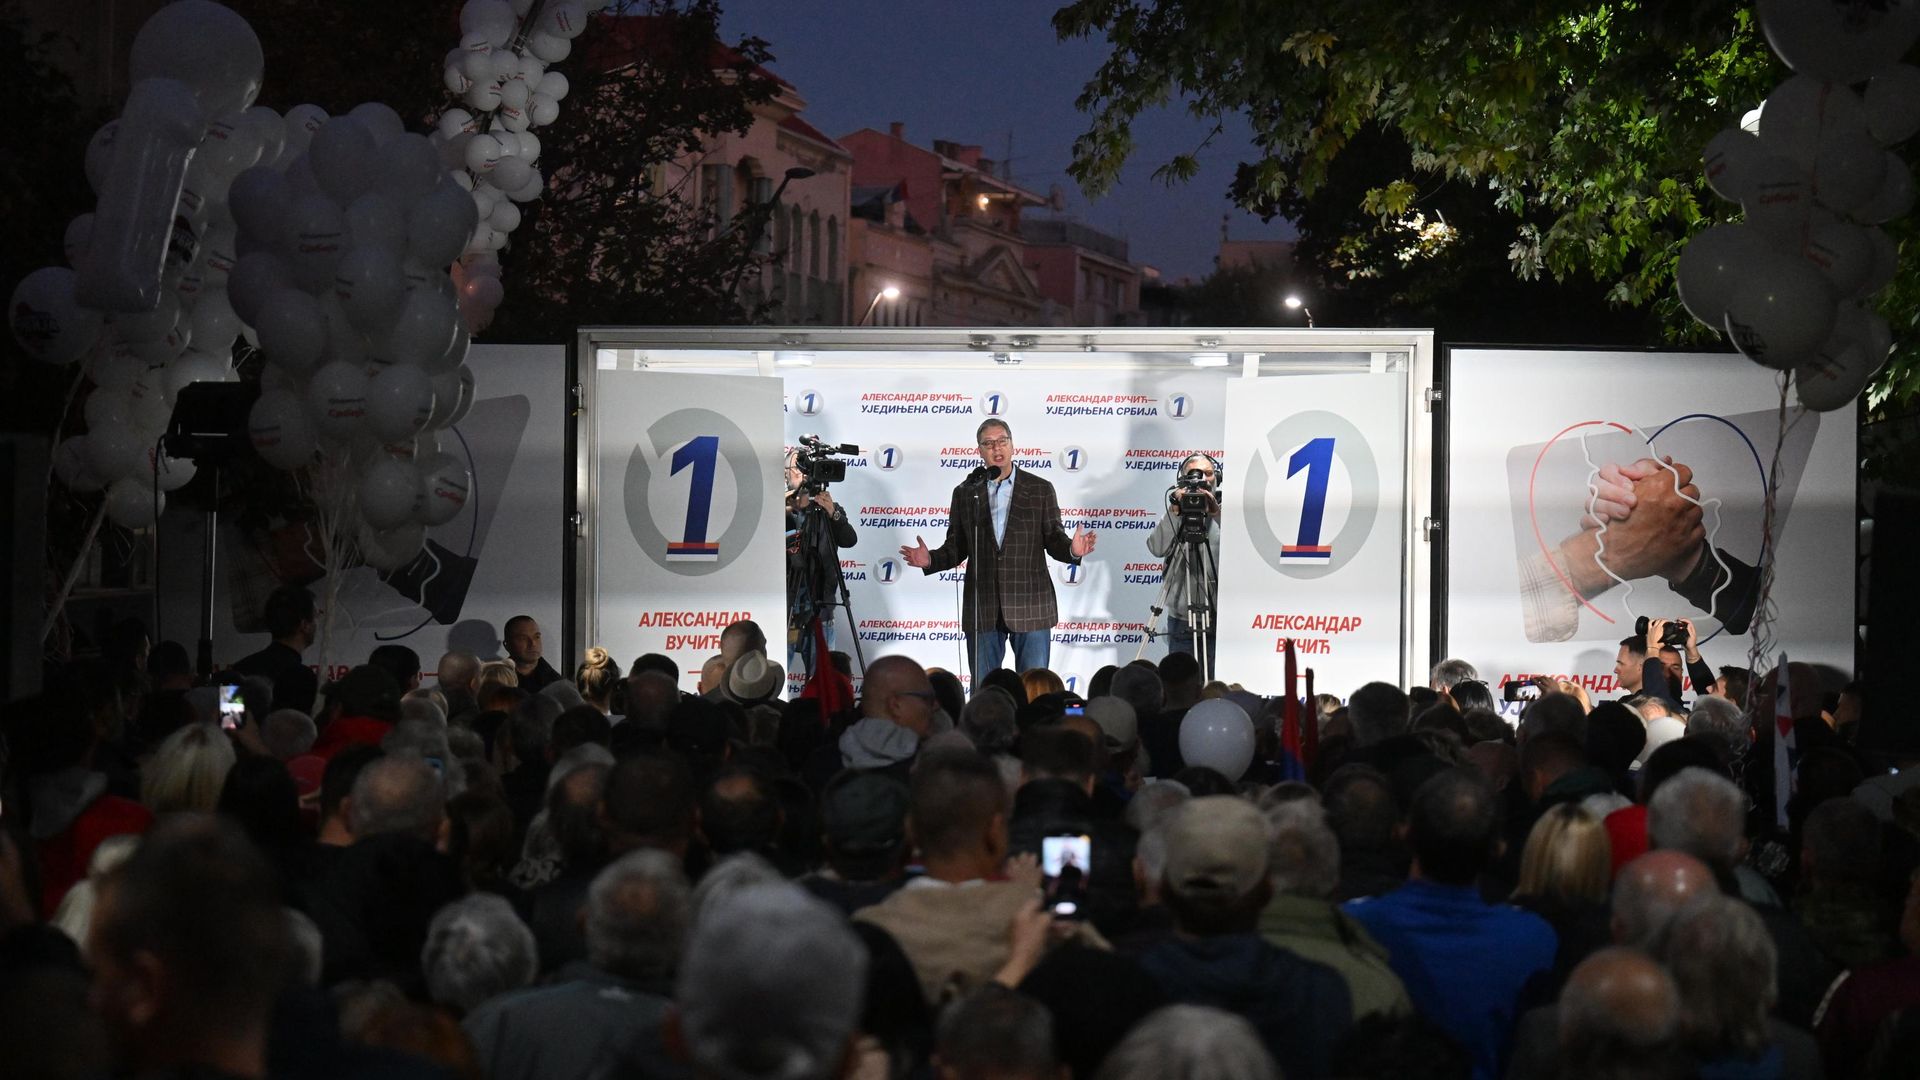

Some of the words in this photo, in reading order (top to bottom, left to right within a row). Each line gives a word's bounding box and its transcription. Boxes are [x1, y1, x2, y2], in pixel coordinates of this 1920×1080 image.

[861, 393, 928, 403] АЛЕКСАНДАР
[1046, 395, 1113, 404] АЛЕКСАНДАР
[861, 405, 928, 415] УЈЕДИЊЕНА
[931, 405, 972, 414] СРБИЈА
[1046, 406, 1113, 416] УЈЕДИЊЕНА
[1116, 407, 1157, 416] СРБИЈА
[940, 447, 980, 455] АЛЕКСА
[1125, 449, 1192, 459] АЛЕКСАНДАР
[665, 436, 720, 561] 1
[1279, 437, 1336, 564] 1
[860, 507, 927, 516] АЛЕКСАНДАР
[1060, 508, 1111, 517] ЕКСАНДАР
[860, 518, 927, 528] УЈЕДИЊЕНА
[1114, 521, 1156, 529] СРБИЈА
[881, 561, 893, 582] 1
[1124, 563, 1163, 571] АЛЕКСА
[859, 620, 926, 629] АЛЕКСАНДАР
[1056, 622, 1110, 631] ЕКСАНДАР
[1252, 614, 1362, 634] АЛЕКСАНДАР
[859, 632, 926, 641] УЈЕДИЊЕНА
[1051, 634, 1112, 643] ЈЕДИЊЕНА
[1114, 634, 1155, 643] СРБИА
[665, 635, 721, 650] ВУЧИЋ
